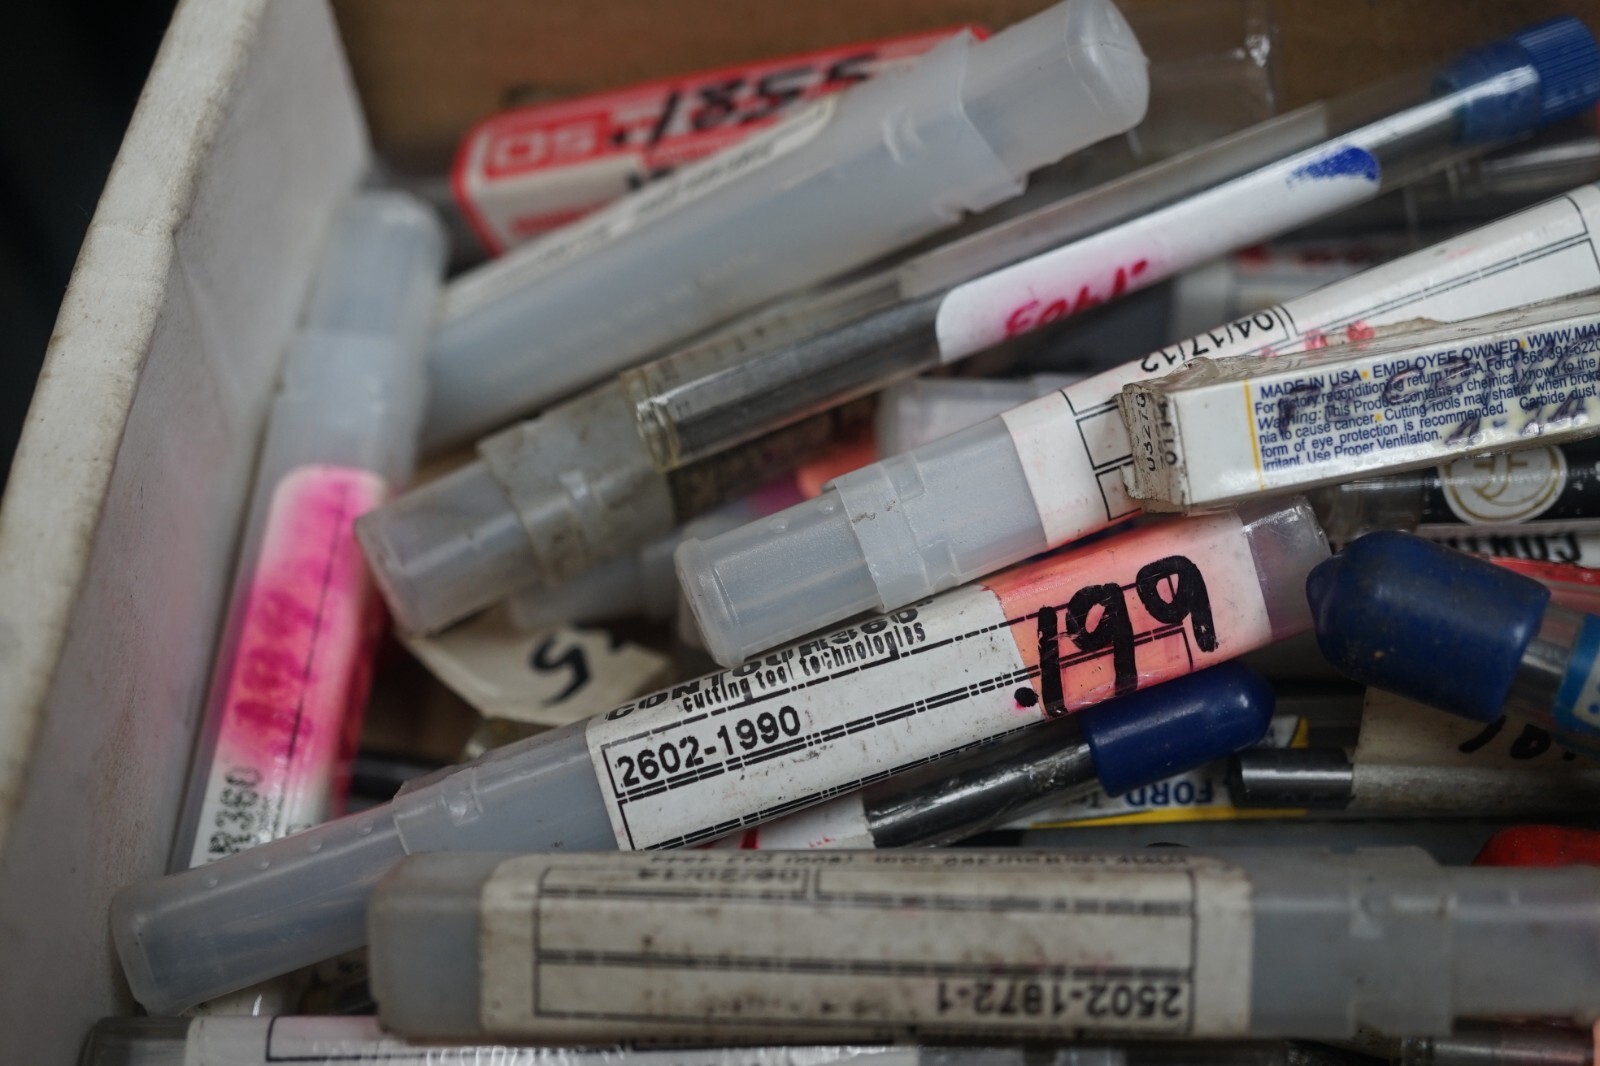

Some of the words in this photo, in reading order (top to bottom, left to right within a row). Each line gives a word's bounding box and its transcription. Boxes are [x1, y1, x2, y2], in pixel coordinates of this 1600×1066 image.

[1255, 402, 1276, 416] For
[1407, 370, 1442, 388] return
[1260, 378, 1305, 401] MADE
[1308, 375, 1325, 389] IN
[1329, 368, 1362, 386] USA
[1373, 349, 1457, 379] EMPLOYEE
[1462, 338, 1521, 361] OWNED
[1466, 369, 1519, 391] chemical
[1577, 357, 1597, 371] the
[1259, 431, 1278, 446] nia
[1295, 422, 1331, 440] cause
[1384, 403, 1427, 422] Cutting
[1492, 383, 1532, 401] shatter
[1535, 377, 1568, 392] when
[1261, 444, 1289, 459] form
[1294, 438, 1307, 453] of
[1312, 436, 1334, 451] eye
[1339, 422, 1397, 447] protection
[1403, 416, 1414, 431] is
[1420, 402, 1508, 429] recommended.
[1519, 391, 1566, 411] Carbide
[1571, 383, 1597, 400] dust
[1306, 449, 1331, 463] Use
[1334, 441, 1374, 460] Proper
[1377, 428, 1443, 450] Ventilation.
[1014, 554, 1219, 718] .199
[616, 704, 800, 788] 2602-1990
[1125, 779, 1214, 807] FORD
